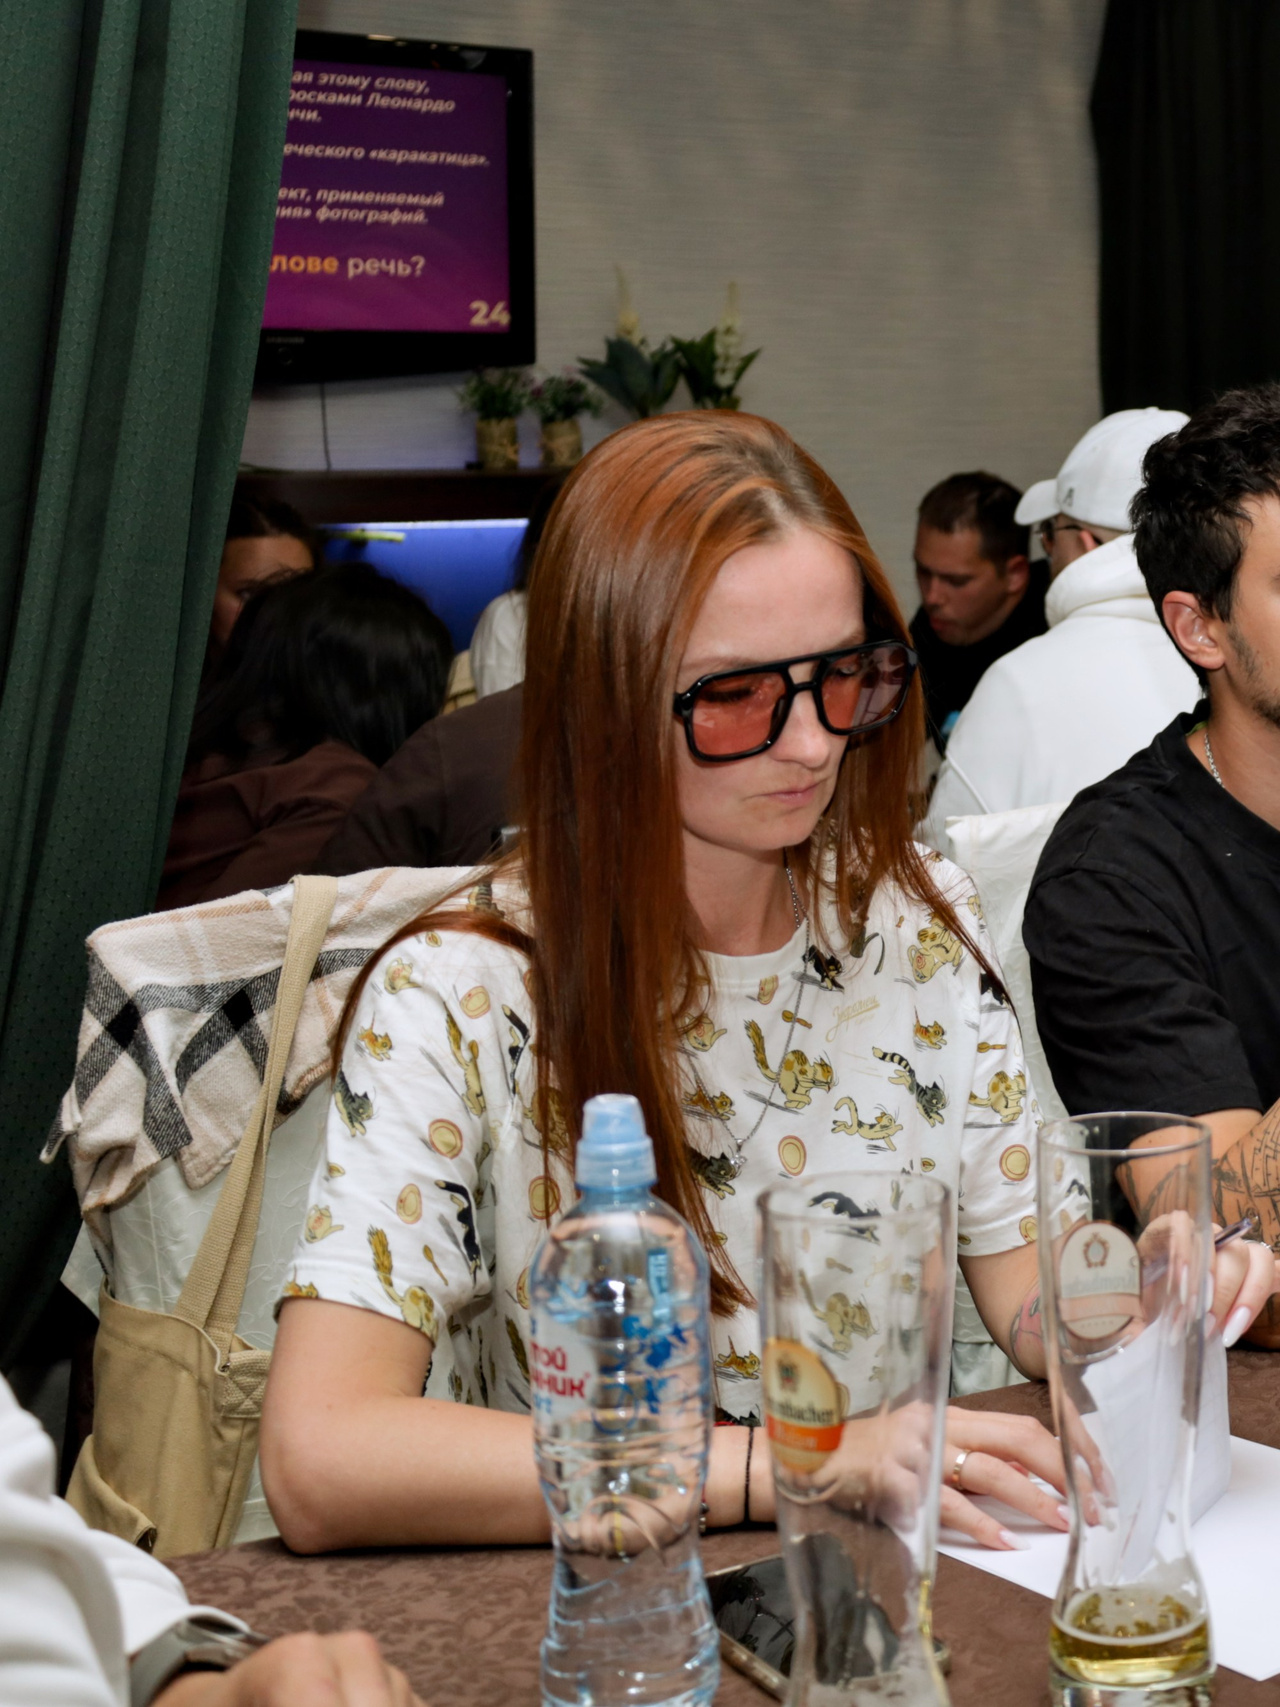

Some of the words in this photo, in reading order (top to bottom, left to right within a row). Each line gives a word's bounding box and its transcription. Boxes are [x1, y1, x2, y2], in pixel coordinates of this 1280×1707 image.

[317, 73, 371, 91] этому
[374, 77, 430, 95] слову,
[289, 89, 362, 106] осками
[366, 92, 456, 114] Леонардо
[284, 143, 365, 160] еческого
[278, 187, 311, 203] ект,
[316, 189, 445, 207] применяемый
[316, 204, 428, 225] фотографий.
[270, 255, 339, 274] лове
[348, 255, 425, 280] речь?
[469, 300, 511, 328] 24
